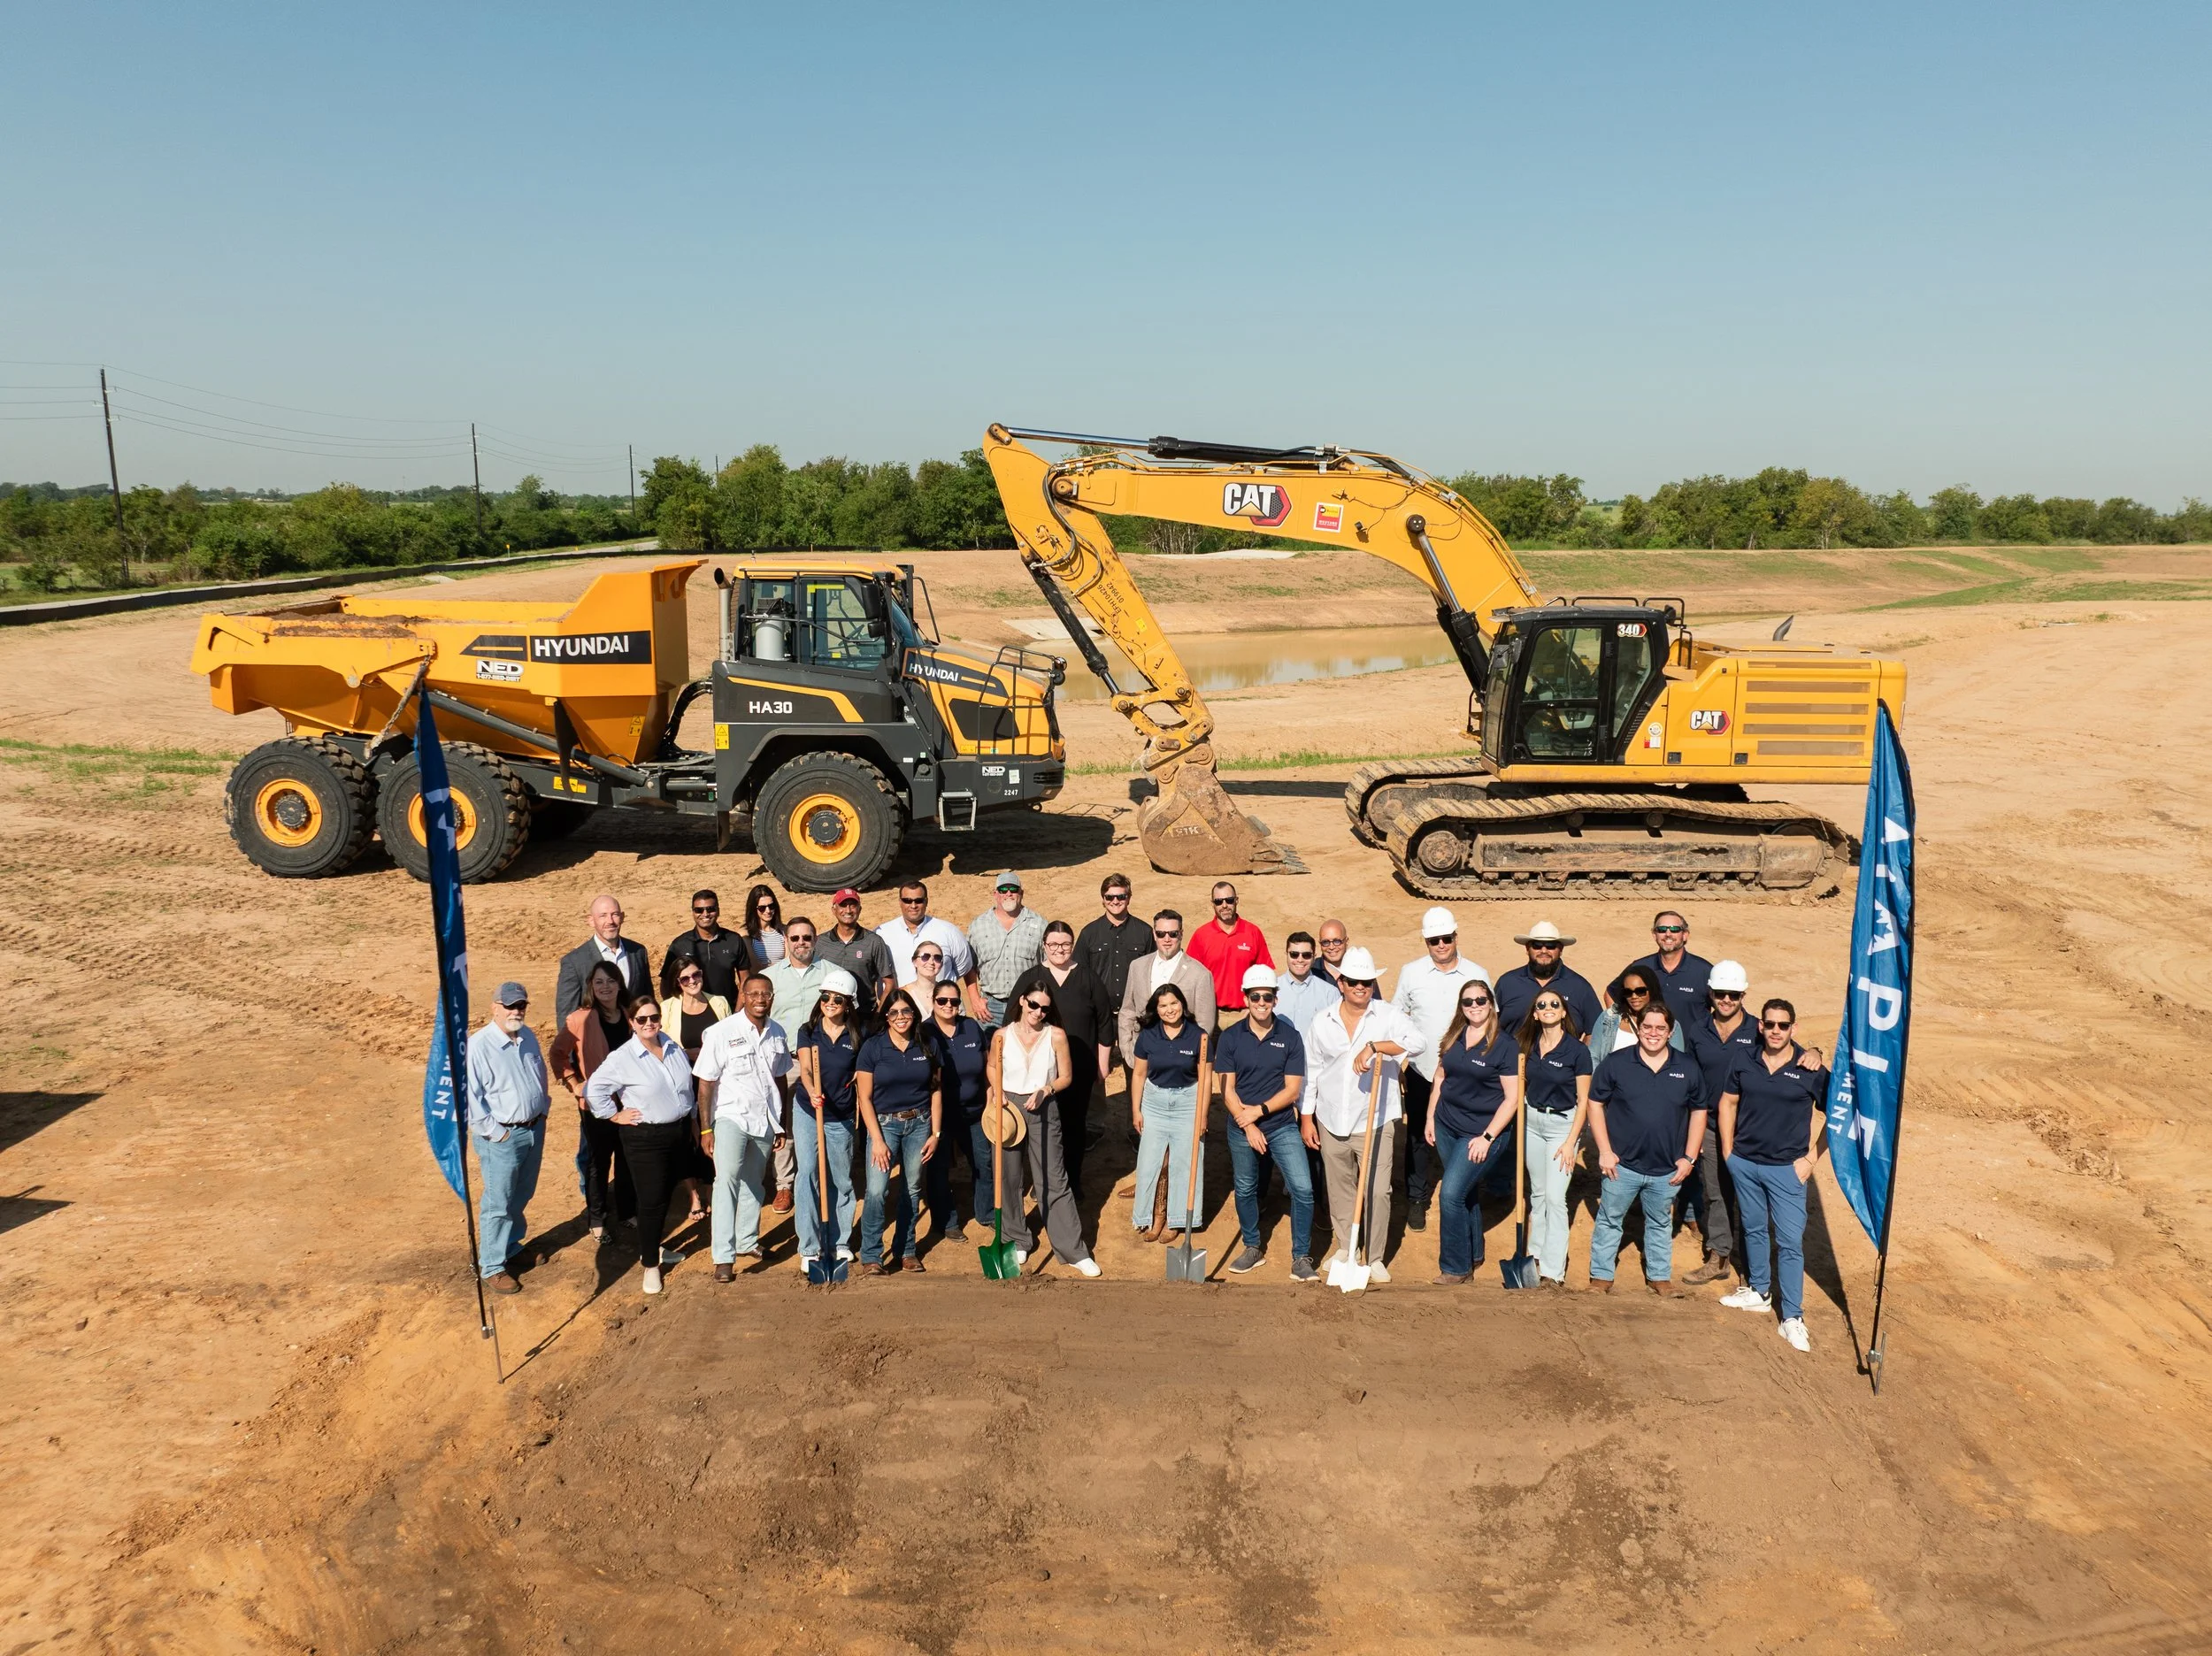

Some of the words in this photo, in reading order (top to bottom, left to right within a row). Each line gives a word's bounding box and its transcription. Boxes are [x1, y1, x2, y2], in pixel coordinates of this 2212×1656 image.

[1224, 482, 1277, 518] CAT
[1617, 624, 1640, 635] 340
[534, 635, 629, 657] HYUNDAI
[476, 659, 524, 675] NED
[909, 663, 959, 681] HYUNDAI
[749, 702, 793, 714] HA30
[1691, 710, 1723, 730] CAT
